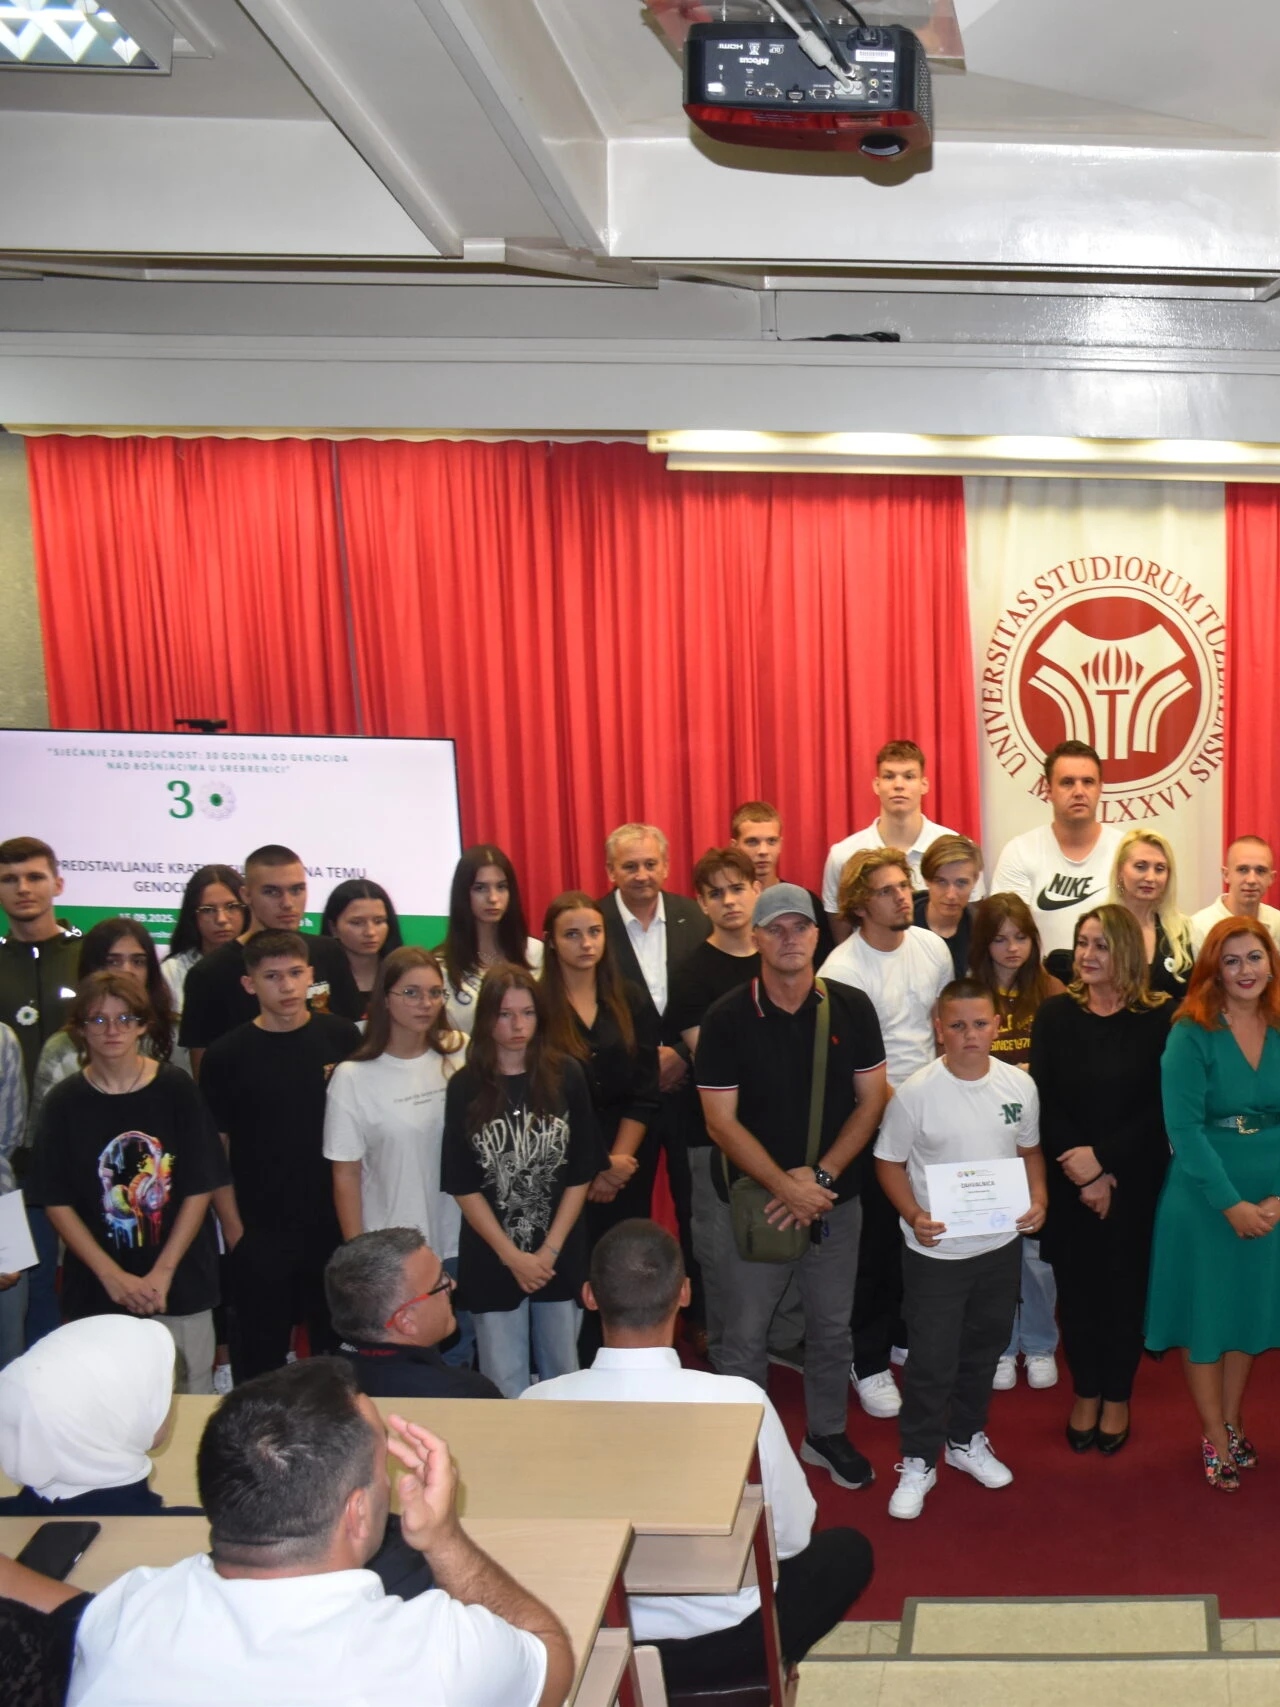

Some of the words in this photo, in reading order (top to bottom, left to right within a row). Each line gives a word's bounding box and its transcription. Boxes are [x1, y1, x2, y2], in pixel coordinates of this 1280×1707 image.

[981, 590, 1038, 778] UNIVERSITAS
[1034, 555, 1204, 614] STUDIORUM
[110, 749, 125, 758] ZA
[222, 752, 268, 761] GODINA
[271, 753, 287, 762] OD
[290, 754, 349, 763] GENOCIDA
[107, 761, 131, 770] NAD
[1028, 774, 1193, 824] MLXXVI
[327, 866, 367, 879] TEMU
[133, 880, 186, 894] GENOCI
[1048, 873, 1094, 897] NIKE
